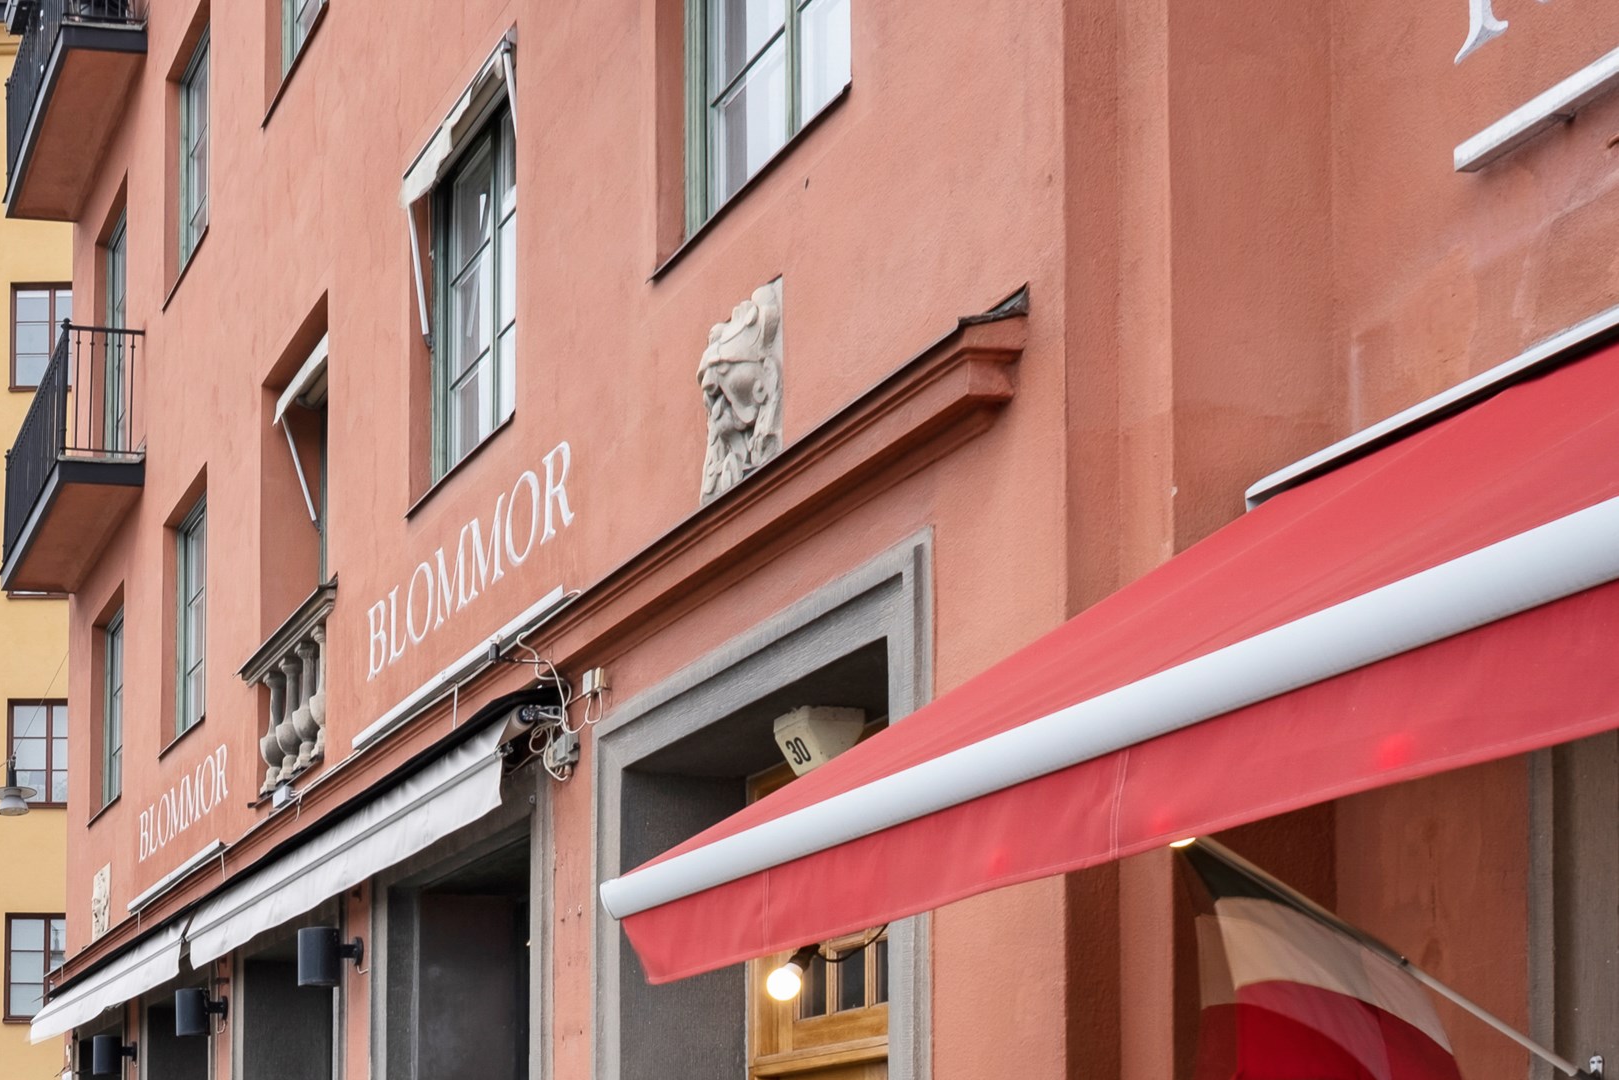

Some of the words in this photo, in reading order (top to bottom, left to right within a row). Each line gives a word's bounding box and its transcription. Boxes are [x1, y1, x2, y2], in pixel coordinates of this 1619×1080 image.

[366, 440, 575, 682] BLOMMOR
[138, 743, 229, 864] BLOMMOR
[785, 736, 812, 766] 30
